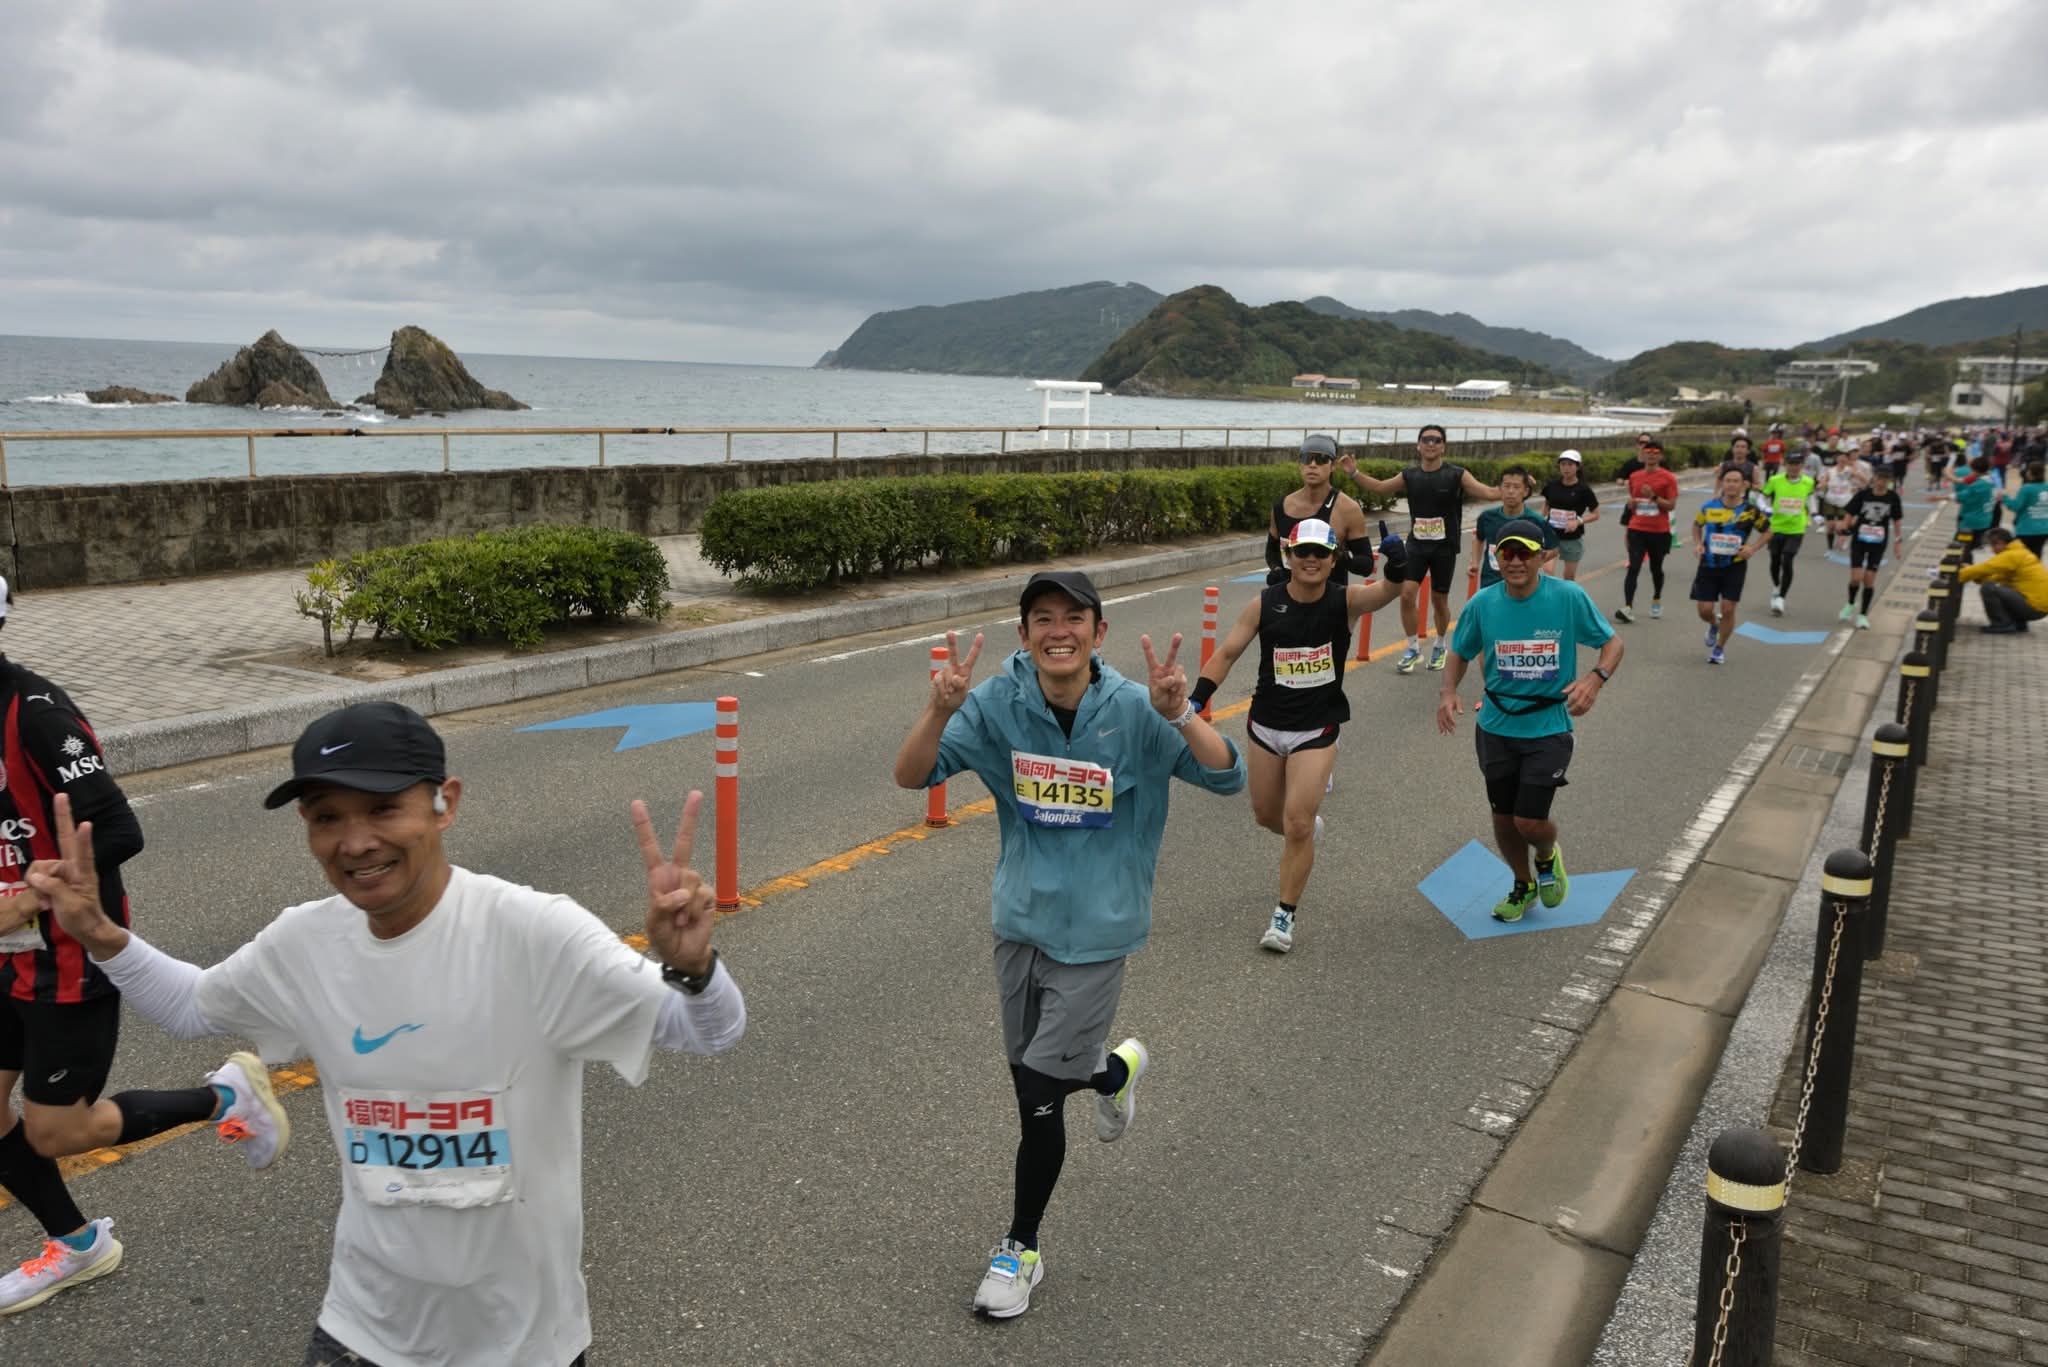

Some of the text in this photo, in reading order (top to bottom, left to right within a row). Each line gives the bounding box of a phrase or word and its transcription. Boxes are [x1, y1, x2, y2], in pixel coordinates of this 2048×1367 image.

[1287, 658, 1331, 675] 14155
[1509, 654, 1557, 667] 13004
[57, 755, 104, 783] MSC
[1015, 758, 1107, 786] 福岡トヨタ
[1017, 781, 1104, 807] E 14135
[1033, 808, 1083, 825] Salonpas
[344, 1098, 493, 1130] 福岡トヨタ
[351, 1131, 497, 1169] D 12914
